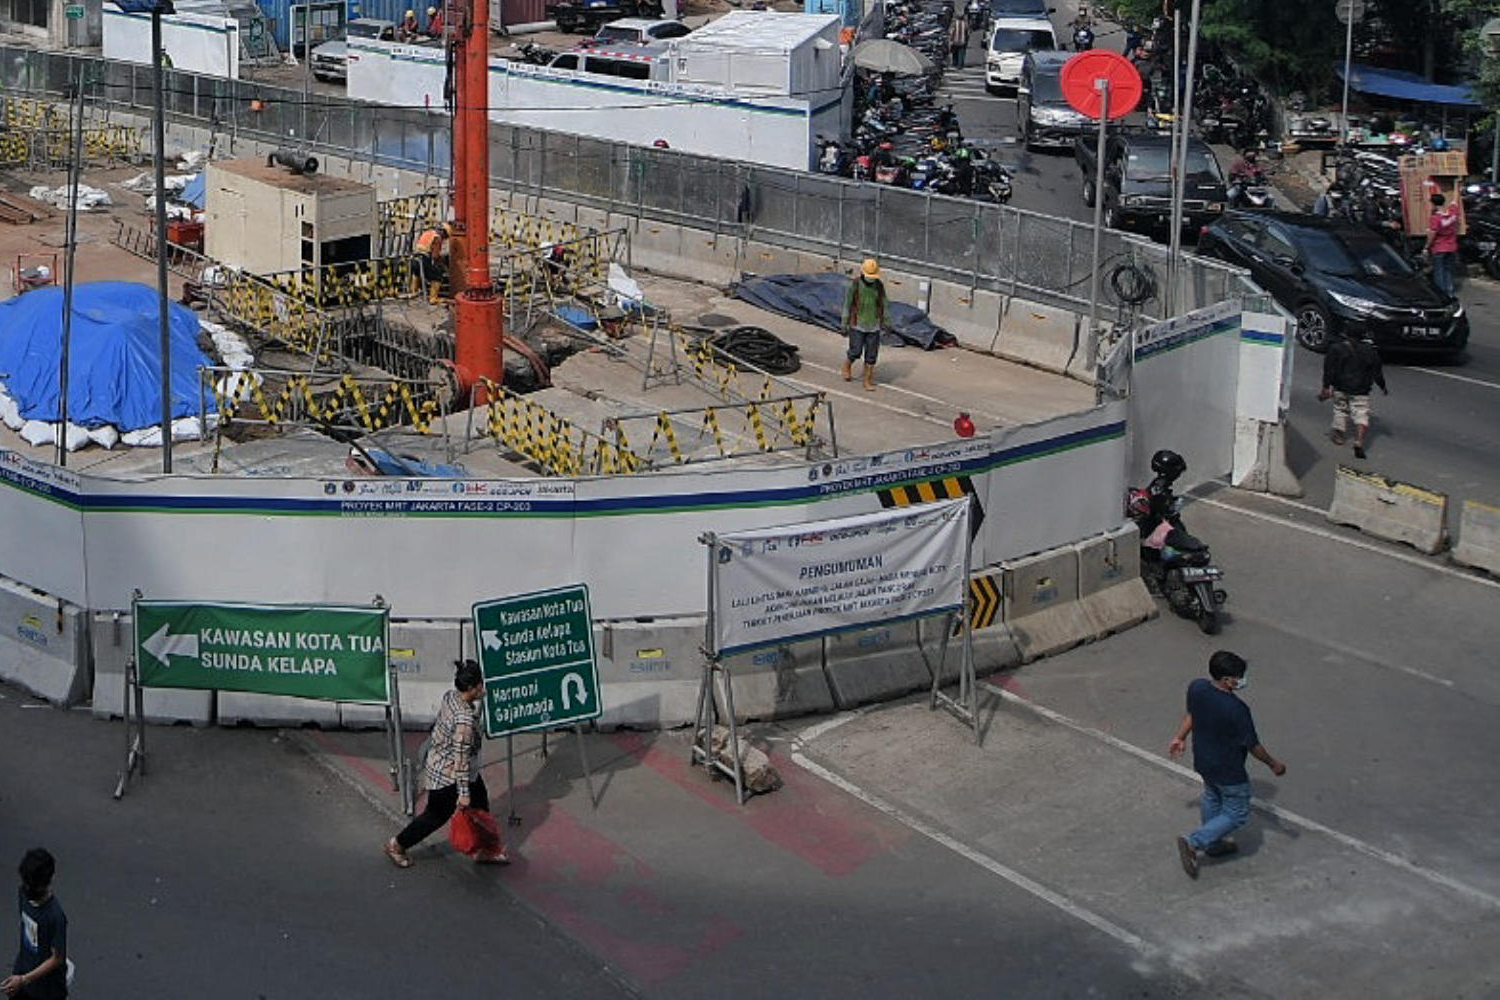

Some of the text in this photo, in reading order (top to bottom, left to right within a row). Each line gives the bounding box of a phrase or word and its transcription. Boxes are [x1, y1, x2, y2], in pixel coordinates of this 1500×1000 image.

[341, 502, 531, 511] PROYEK MRT JAKARTA FASE-2 CP-203
[799, 554, 883, 580] PENGUMUMAN
[500, 599, 584, 626] Kawasan Kota Tua
[200, 628, 384, 653] KAWASAN KOTA TUA
[502, 622, 571, 647] Sunda Kelapa
[201, 653, 337, 675] SUNDA KELAPA
[505, 640, 586, 666] Stasiun Kota Tua
[493, 679, 539, 702] Harmoni
[495, 698, 554, 723] Gajahmada
